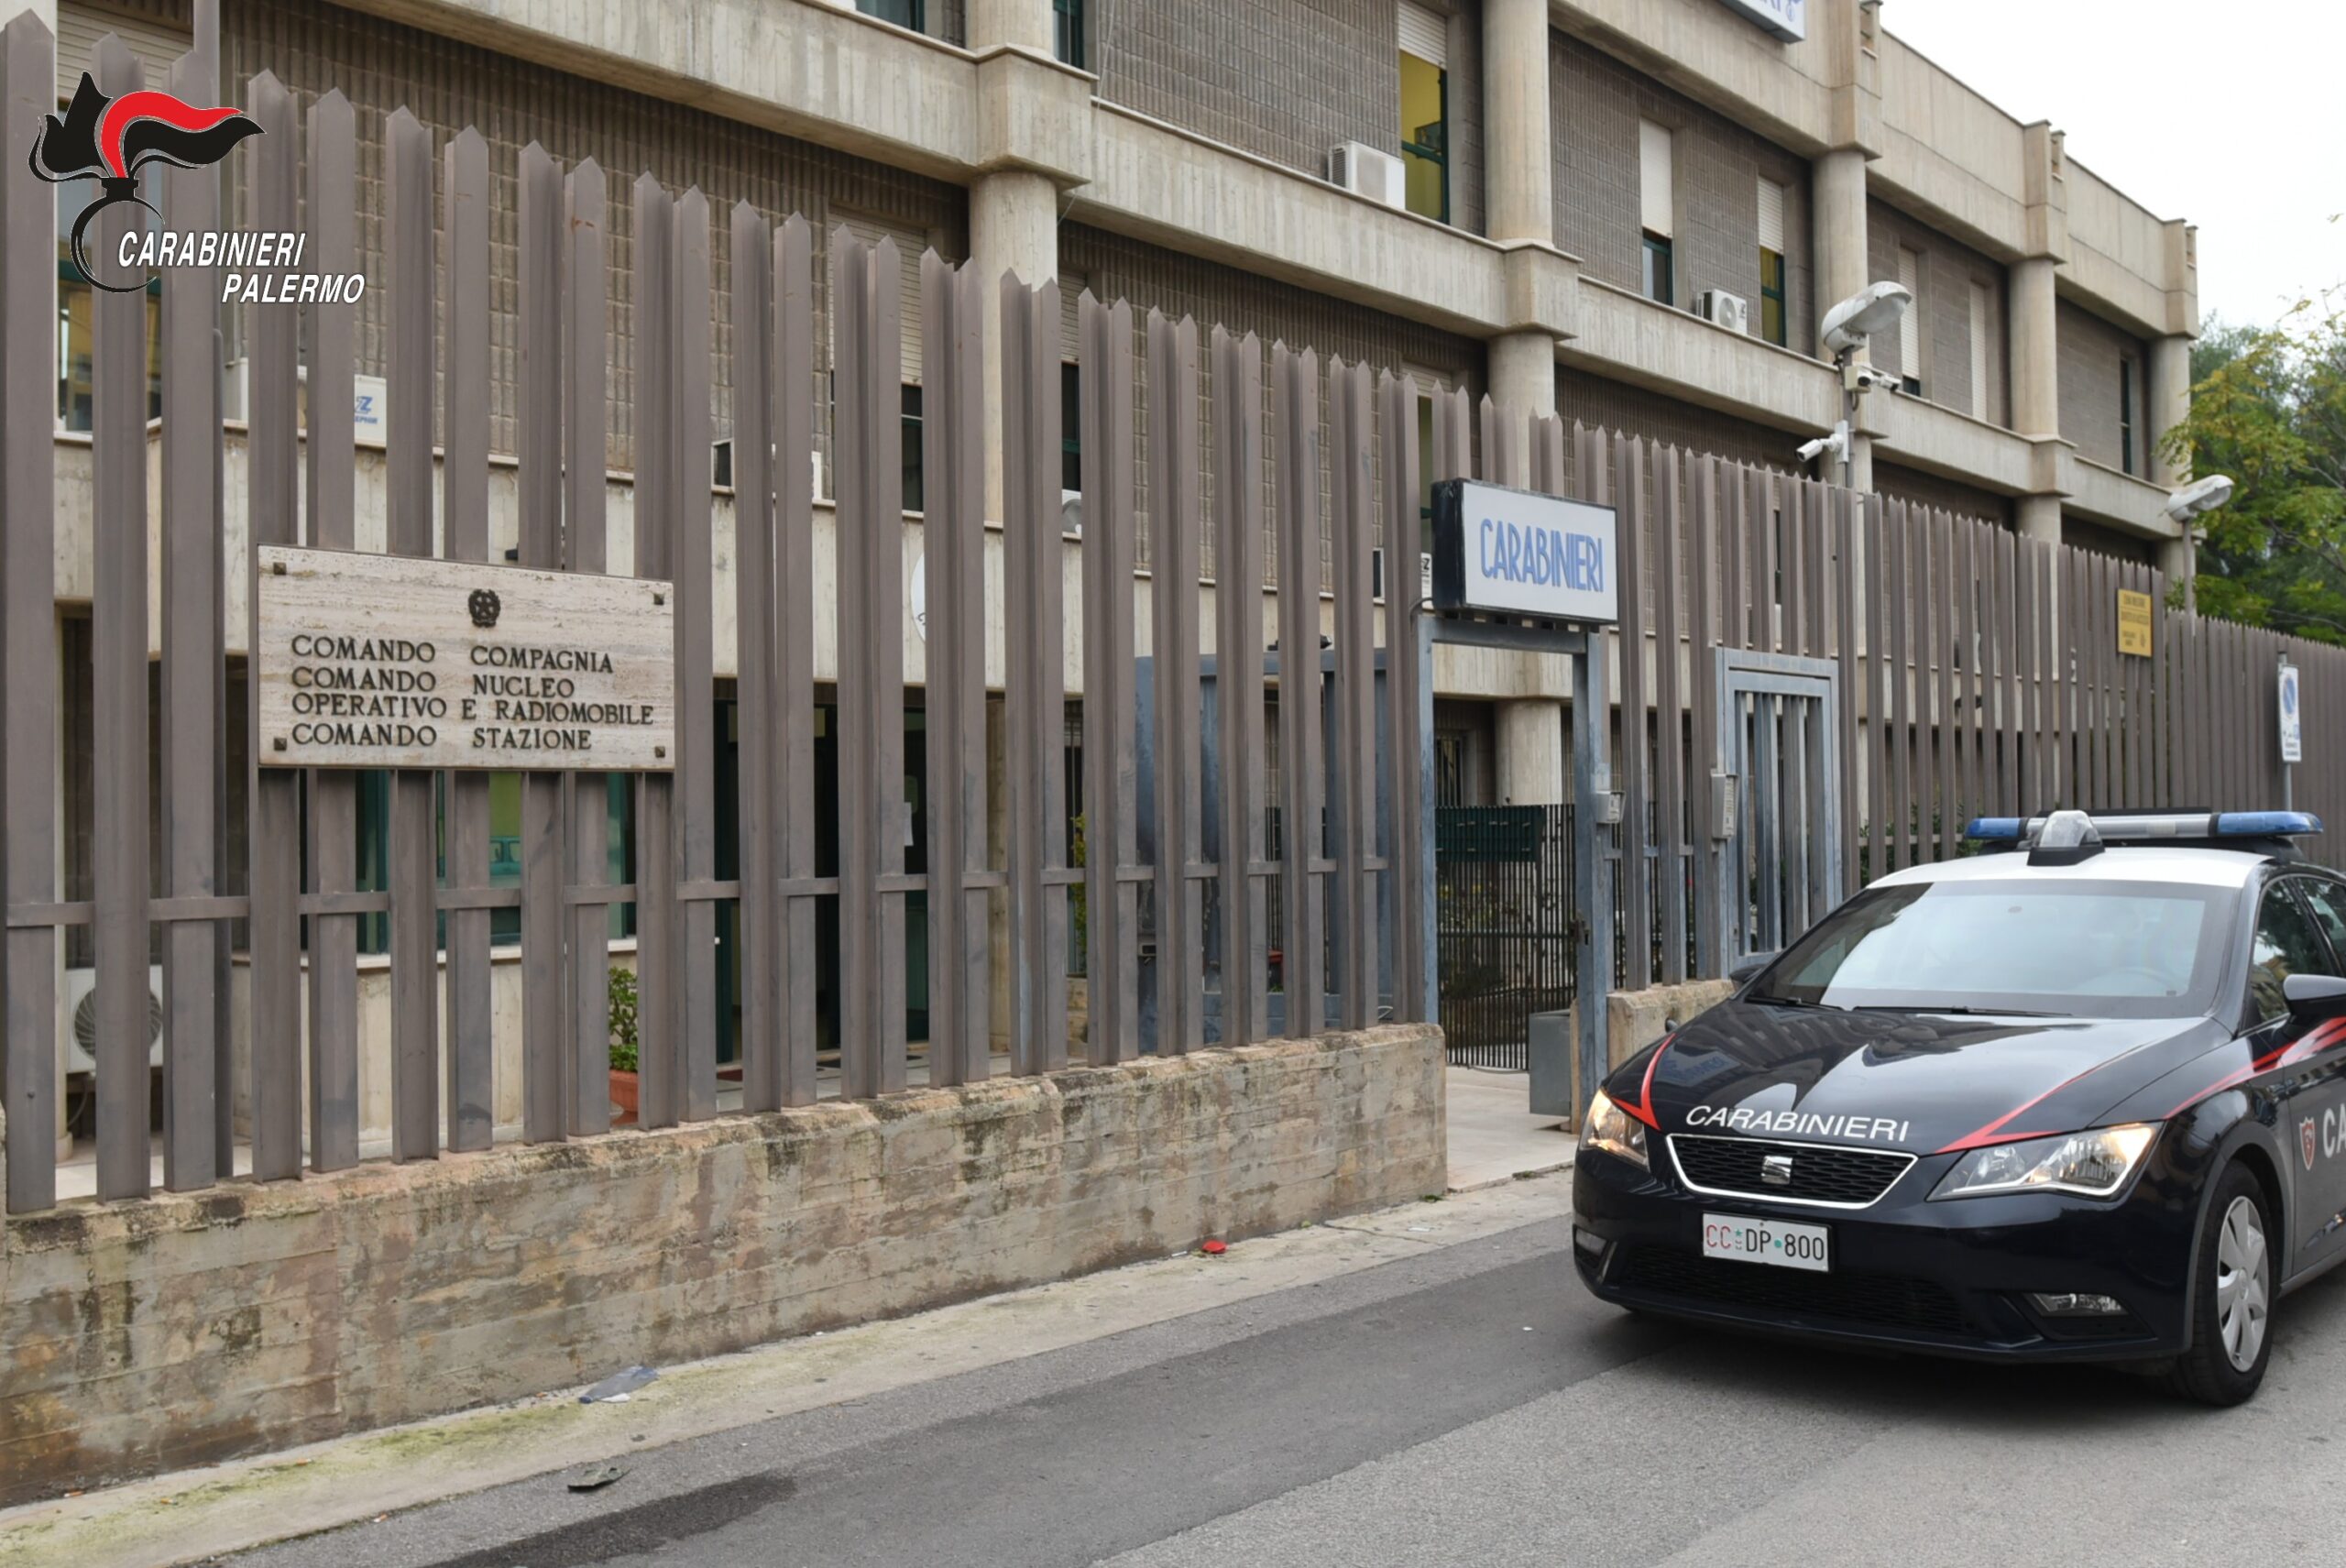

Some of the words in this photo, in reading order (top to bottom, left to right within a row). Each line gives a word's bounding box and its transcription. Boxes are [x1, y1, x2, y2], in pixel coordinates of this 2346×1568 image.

[1480, 519, 1604, 593] CARABINIERI
[291, 635, 435, 662] COMANDO
[470, 645, 613, 674] COMPAGNIA
[291, 667, 436, 693] COMANDO
[473, 674, 575, 697] NUCLEO
[292, 693, 446, 718] OPERATIVO
[462, 698, 477, 720] E
[495, 699, 653, 725] RADIOMOBILE
[292, 723, 436, 747] COMANDO
[473, 728, 592, 750] STAZIONE
[1685, 1105, 1909, 1142] CARABINIERI
[1706, 1224, 1731, 1249] CC
[1746, 1228, 1771, 1254] DP
[1784, 1234, 1825, 1260] 800
